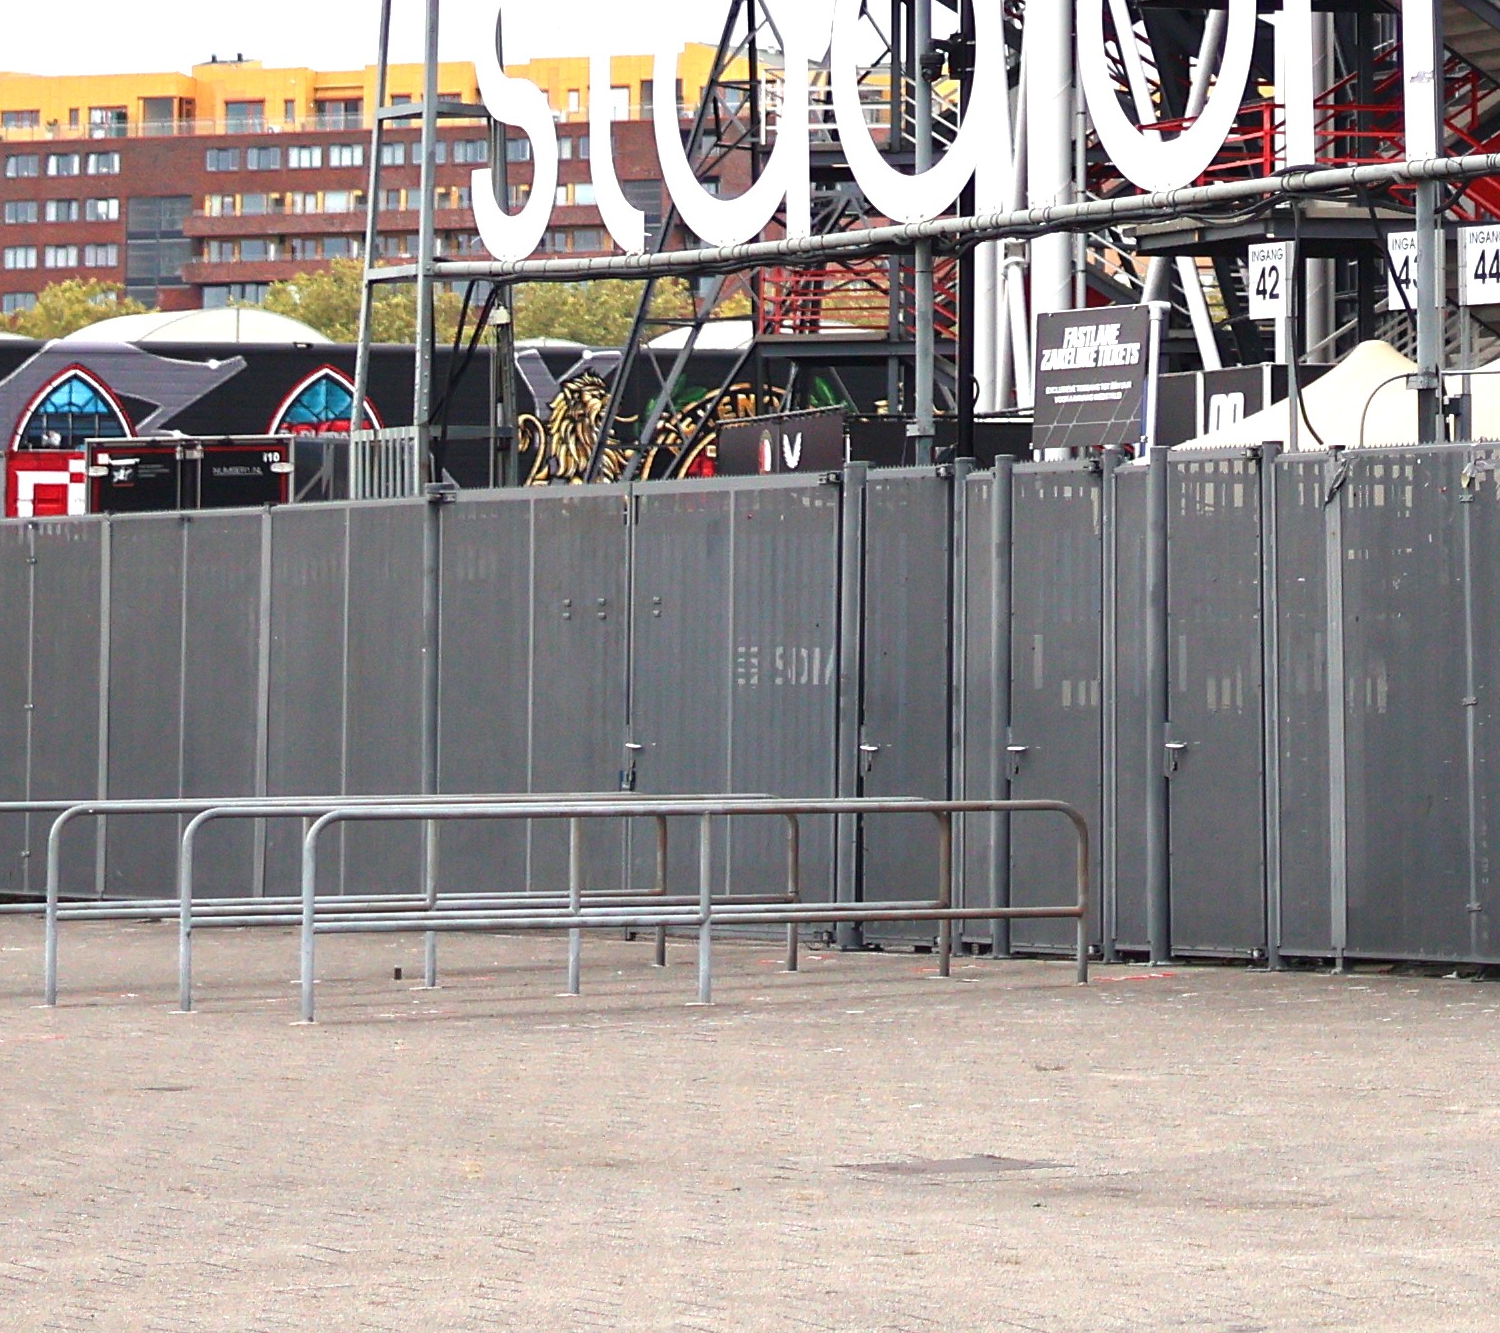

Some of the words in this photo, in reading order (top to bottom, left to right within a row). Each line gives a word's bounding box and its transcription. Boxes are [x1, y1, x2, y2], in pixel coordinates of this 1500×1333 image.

[1251, 247, 1284, 263] INGANG
[1391, 237, 1416, 251] INGA
[1255, 265, 1280, 301] 42
[1397, 254, 1418, 290] 4
[1062, 323, 1122, 349] FASTLANE
[1097, 342, 1141, 367] TICKETS
